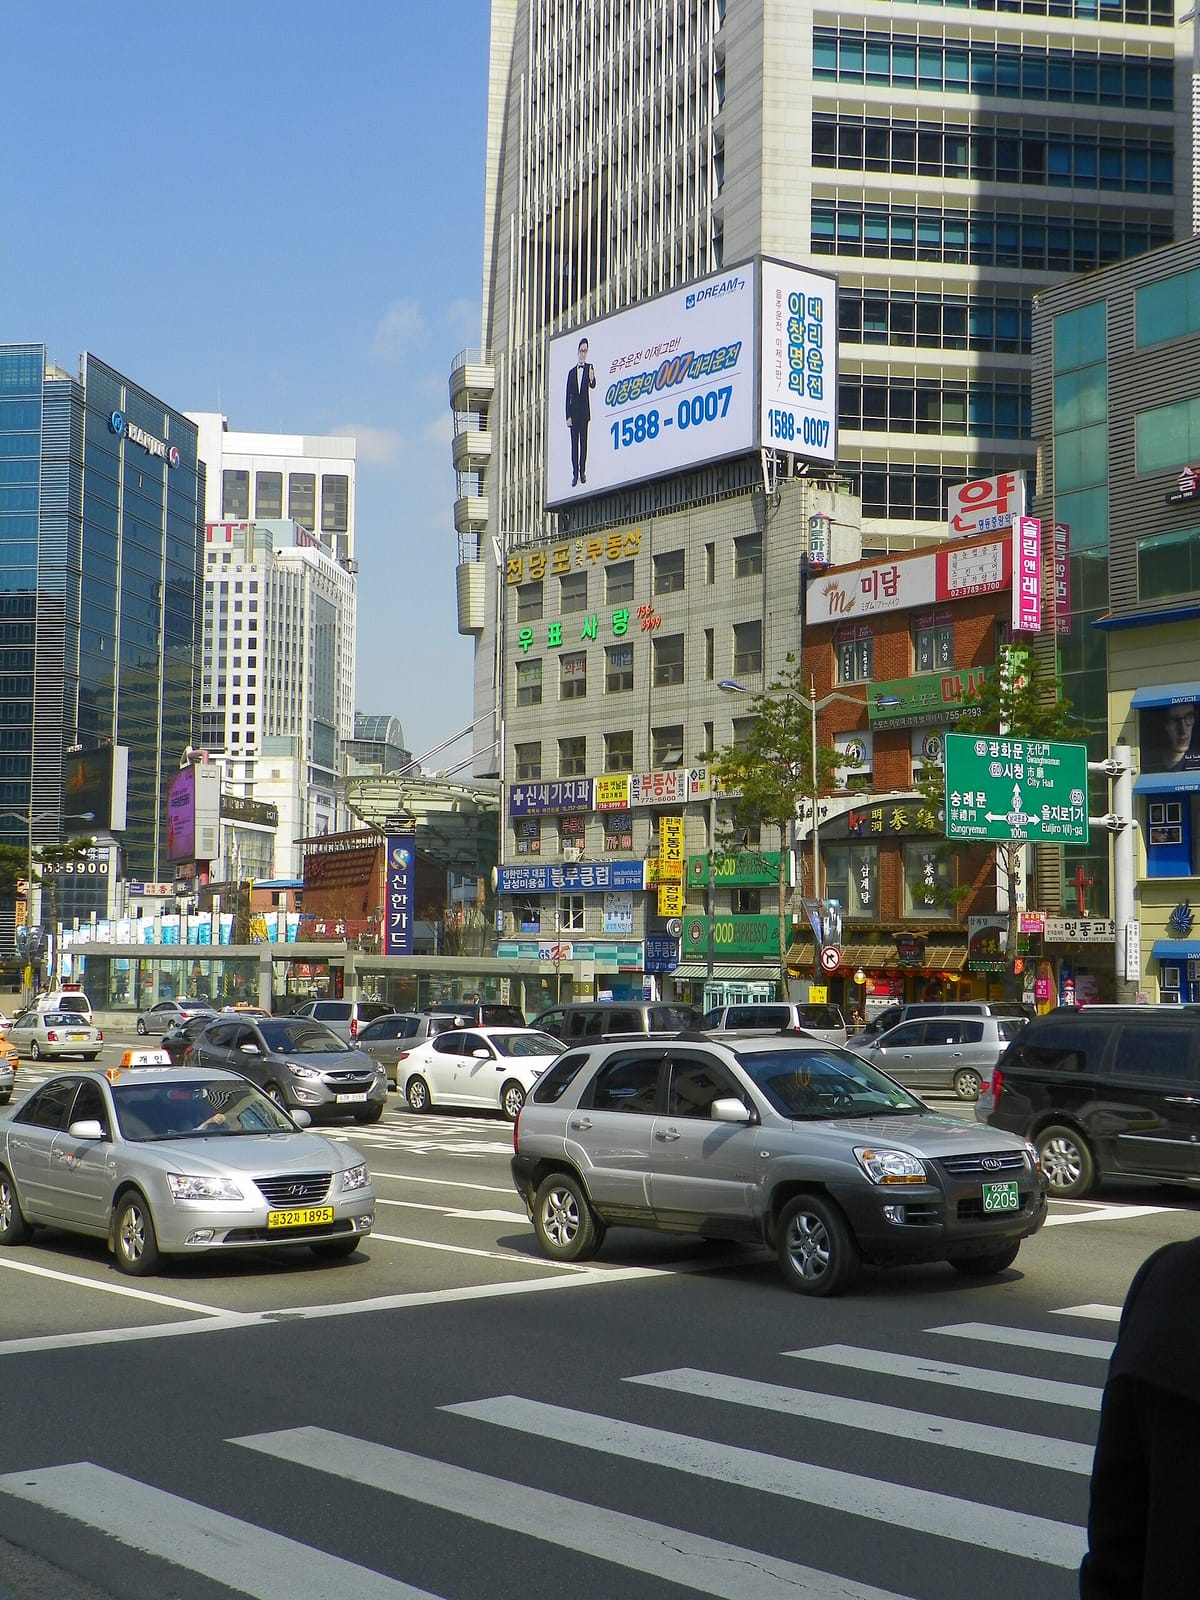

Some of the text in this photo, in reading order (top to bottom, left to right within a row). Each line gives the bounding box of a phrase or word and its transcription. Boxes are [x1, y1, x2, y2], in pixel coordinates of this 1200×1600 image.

[788, 292, 805, 397] 이창명의
[807, 297, 823, 400] 대리운전
[958, 474, 1015, 515] 약
[811, 520, 825, 551] 아로마
[507, 544, 571, 586] 전당포
[586, 527, 642, 564] 부동산
[810, 552, 825, 562] 3층
[1022, 521, 1038, 613] 슬림앤레그
[861, 566, 900, 600] 미담
[951, 581, 1000, 597] 02-3789-3700
[989, 741, 1023, 759] 광화문
[1027, 743, 1050, 756] 光化門
[1003, 763, 1024, 780] 시청
[641, 772, 677, 797] 부동산
[1027, 779, 1054, 789] City Hall
[526, 781, 589, 806] 신세기치과
[950, 790, 987, 808] 숭례문
[1041, 805, 1084, 822] 을지로1가
[951, 822, 987, 836] Sungryemun
[1010, 828, 1027, 839] 100m
[667, 826, 680, 860] 부동산
[503, 868, 546, 878] 대한민국 대표
[551, 866, 609, 888] 블루클럽
[503, 879, 546, 889] 남성미용실
[860, 864, 871, 904] 삼계탕
[390, 874, 409, 947] 신한카드
[714, 922, 734, 943] OOD
[647, 942, 677, 957] 블루클럽
[584, 984, 590, 993] 3
[985, 1191, 1017, 1209] 6205
[303, 1209, 329, 1223] 1895
